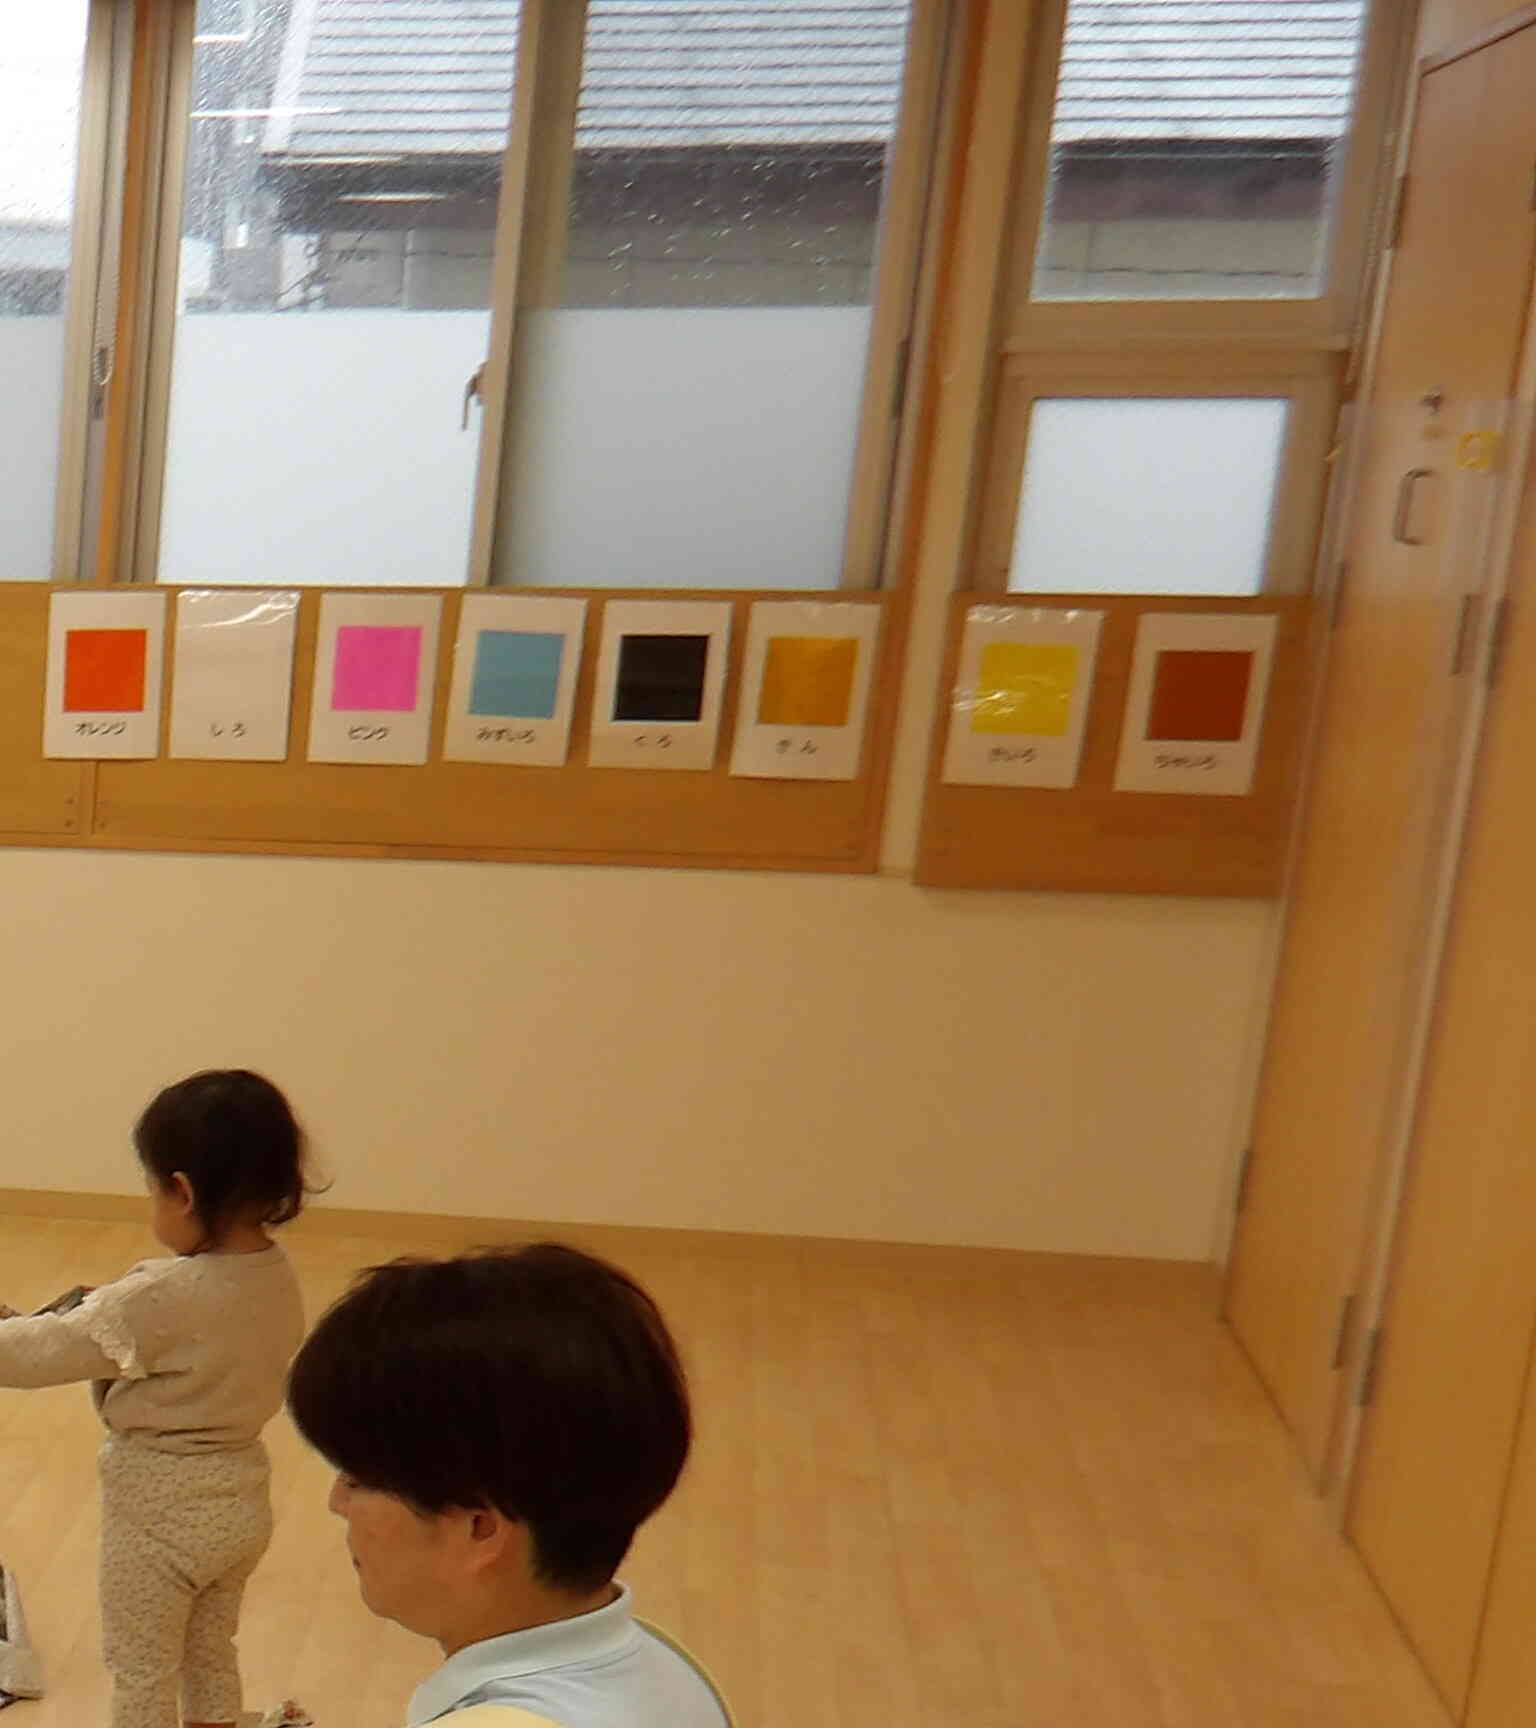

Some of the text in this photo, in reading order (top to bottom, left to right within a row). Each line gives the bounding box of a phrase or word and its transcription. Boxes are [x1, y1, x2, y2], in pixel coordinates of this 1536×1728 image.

[74, 721, 126, 736] オレンジ
[348, 725, 390, 741] ピンク
[476, 726, 536, 744] みずいろ
[988, 747, 1037, 763] きいろ
[1154, 754, 1217, 770] ちゃいろ
